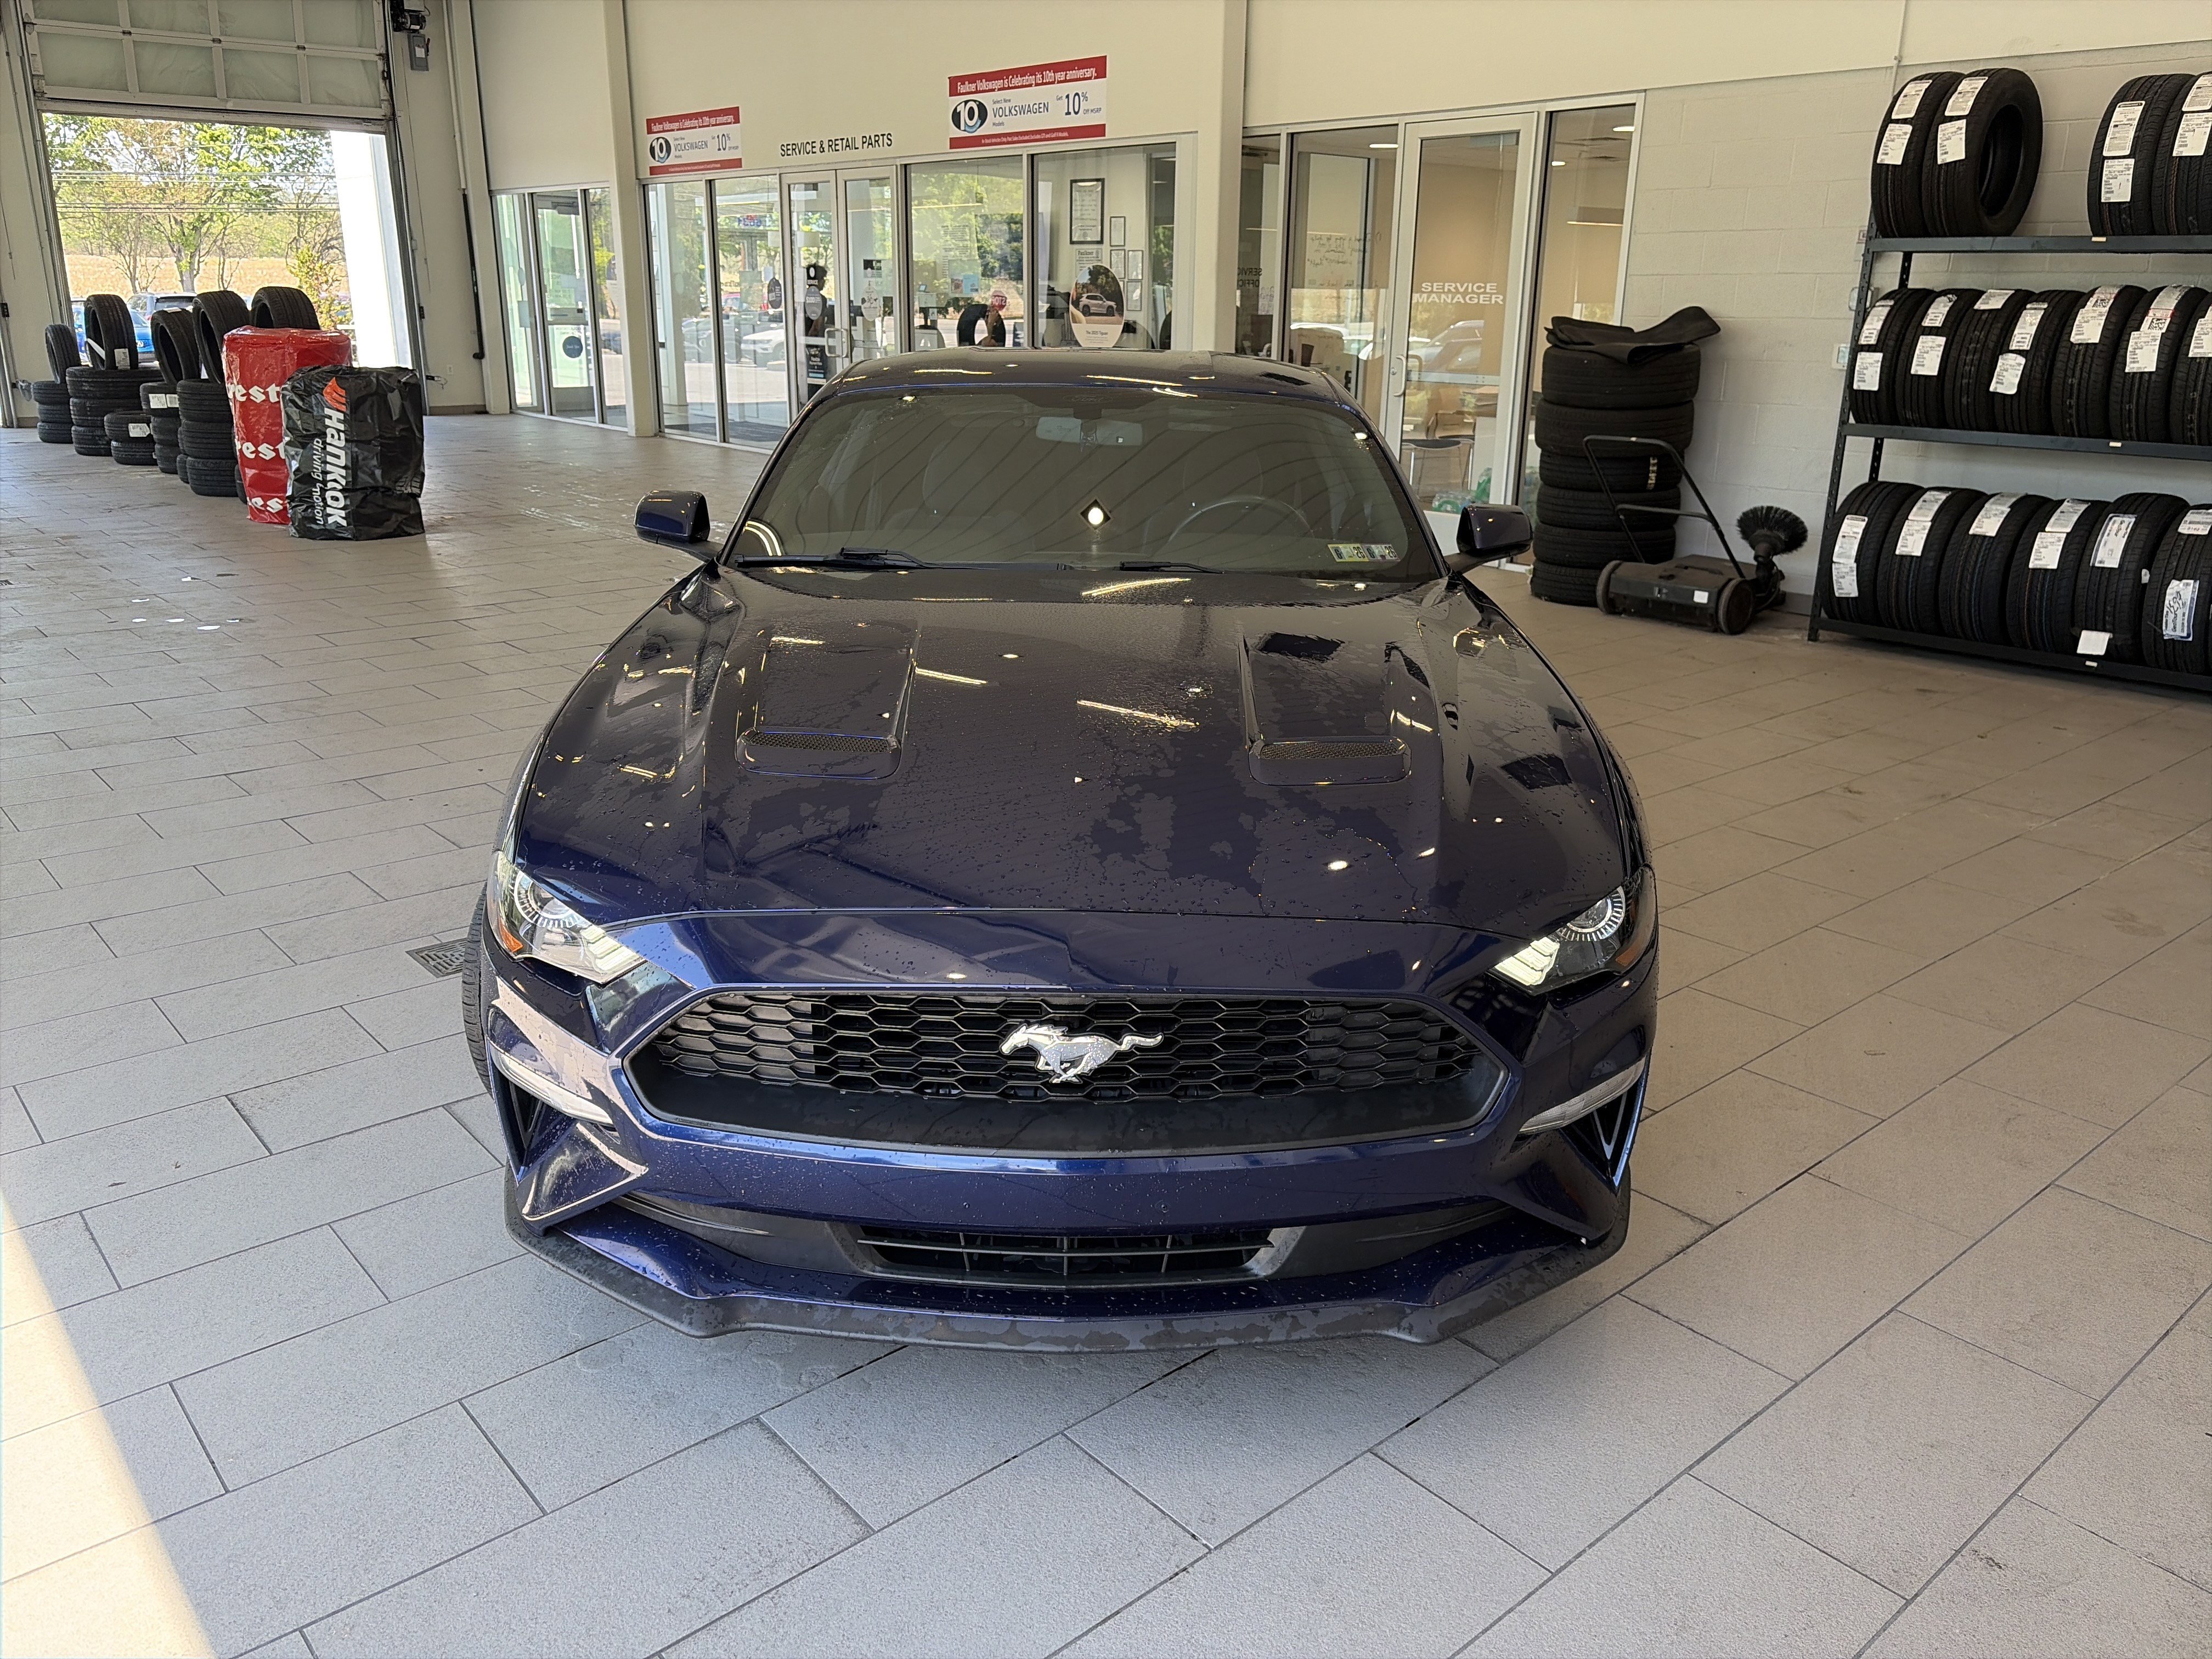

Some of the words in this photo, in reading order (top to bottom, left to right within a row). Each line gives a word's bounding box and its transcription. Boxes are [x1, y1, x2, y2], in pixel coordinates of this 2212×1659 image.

[957, 81, 976, 93] Faulkner
[977, 78, 1003, 91] Volkswagen
[1003, 76, 1008, 87] is
[1009, 72, 1035, 87] Celebrating
[1043, 70, 1054, 82] 10th
[1055, 71, 1066, 84] year
[1066, 66, 1097, 80] anniversary.
[992, 101, 1049, 118] VOLKSWAGEN
[674, 140, 708, 152] VOLKSWAGEN
[780, 140, 817, 157] SERVICE
[819, 140, 825, 154] &
[828, 137, 859, 153] RETAIL
[861, 133, 893, 149] PARTS
[1421, 282, 1497, 293] SERVICE
[1412, 293, 1504, 304] MANAGER
[311, 438, 323, 481] driving
[1334, 549, 1343, 560] 6
[1367, 548, 1375, 559] 6
